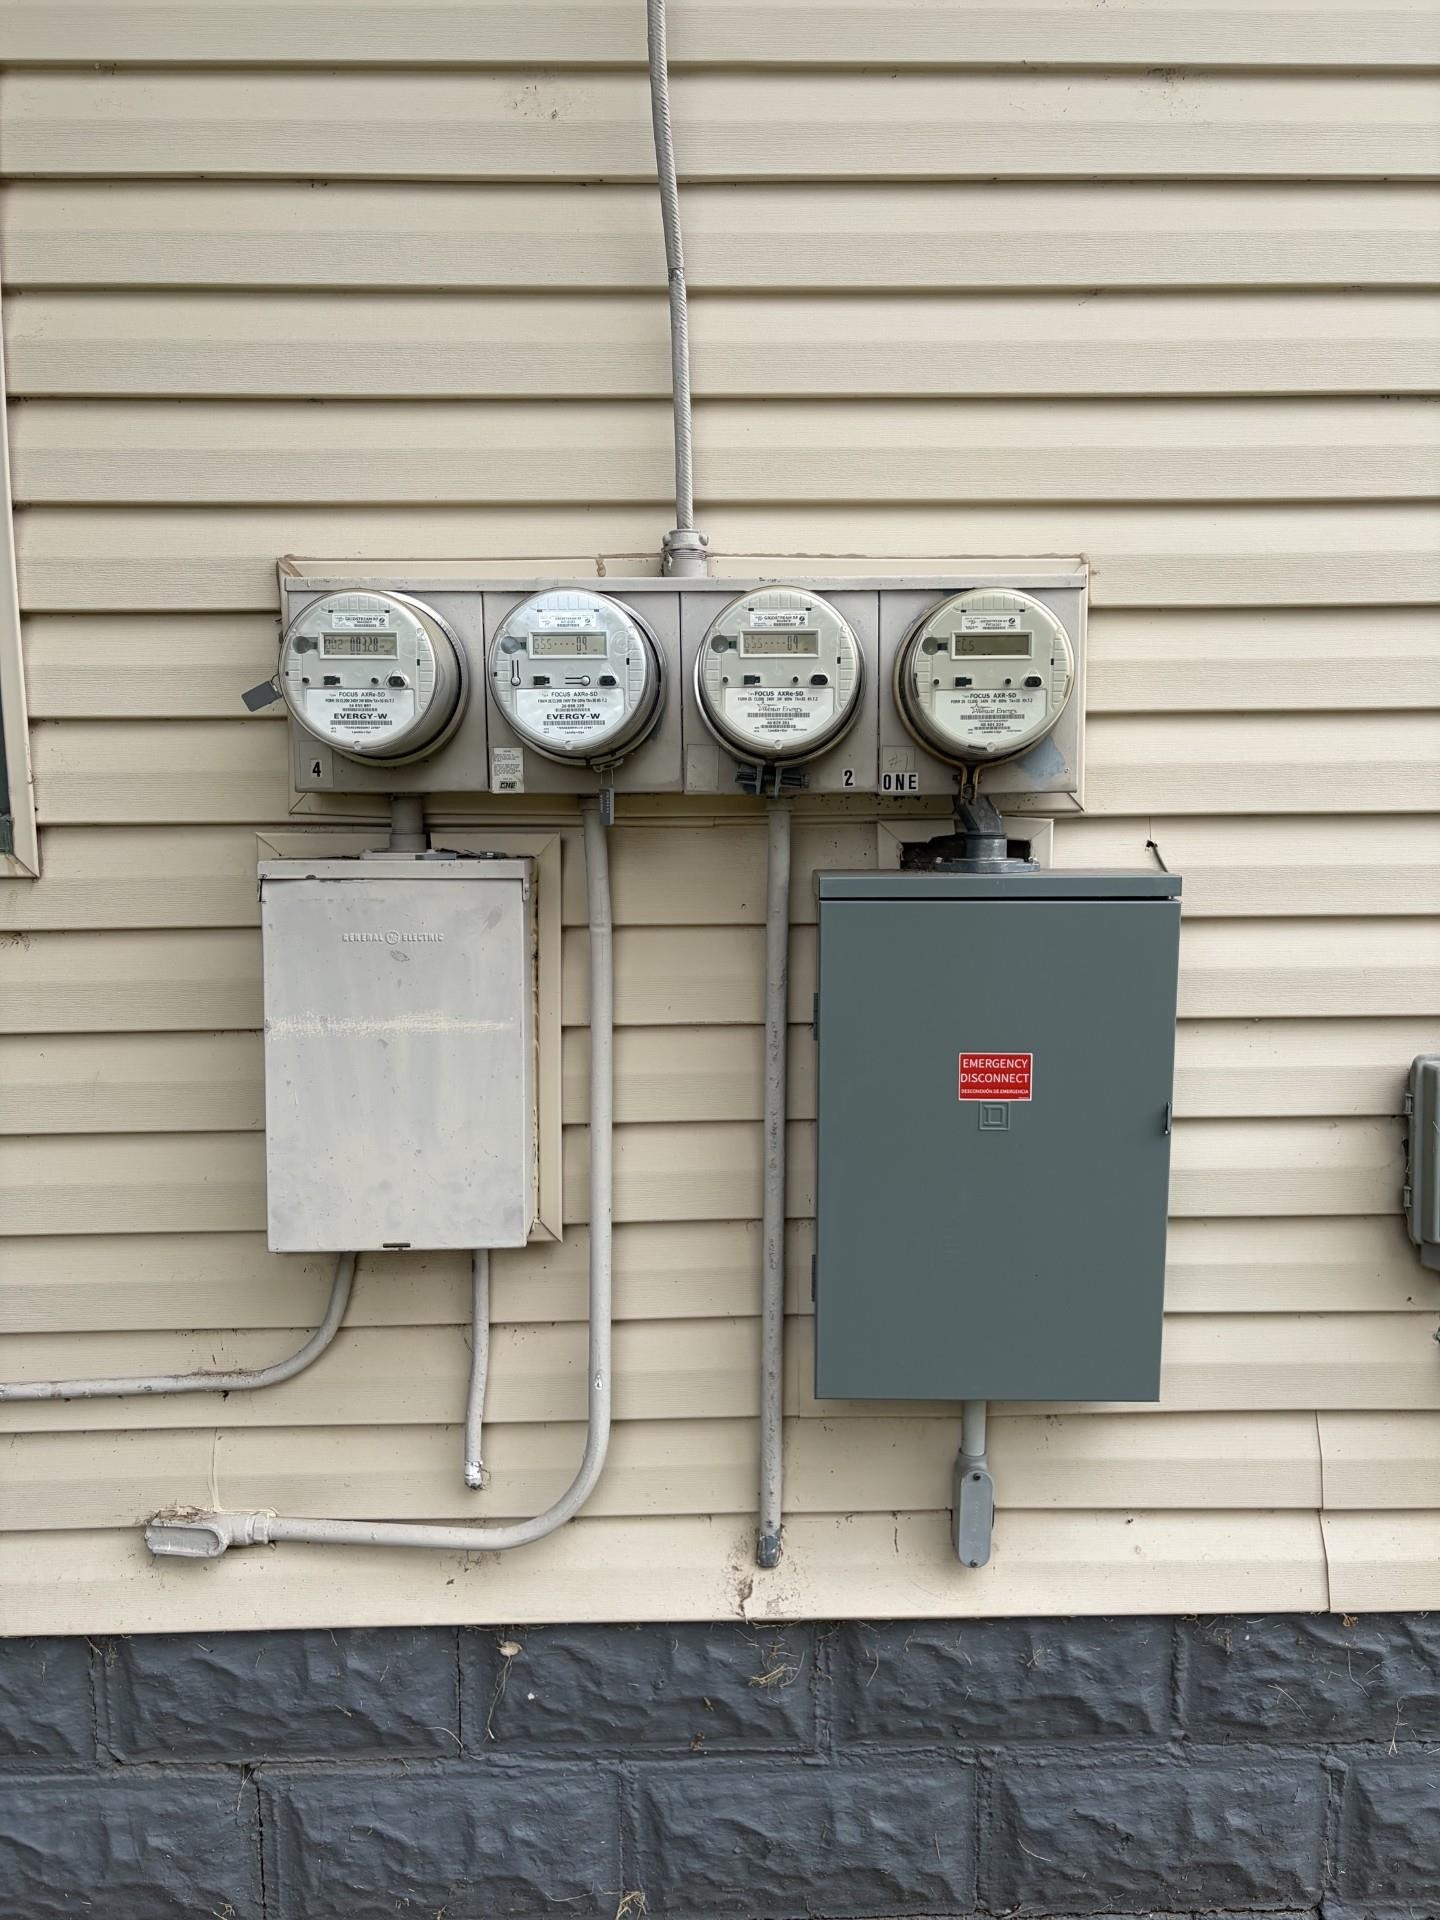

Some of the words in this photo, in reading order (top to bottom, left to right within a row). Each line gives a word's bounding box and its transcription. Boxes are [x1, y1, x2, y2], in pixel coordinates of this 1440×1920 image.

[333, 712, 388, 720] EVERGY-W
[546, 712, 600, 720] EVERGY-W
[312, 761, 322, 777] 4
[844, 769, 854, 786] 2
[883, 773, 917, 791] ONE
[342, 932, 383, 942] GENERAL
[401, 932, 444, 942] ELECTRIC
[962, 1058, 1028, 1069] EMERGENCY
[960, 1073, 1030, 1083] DISCONNECT
